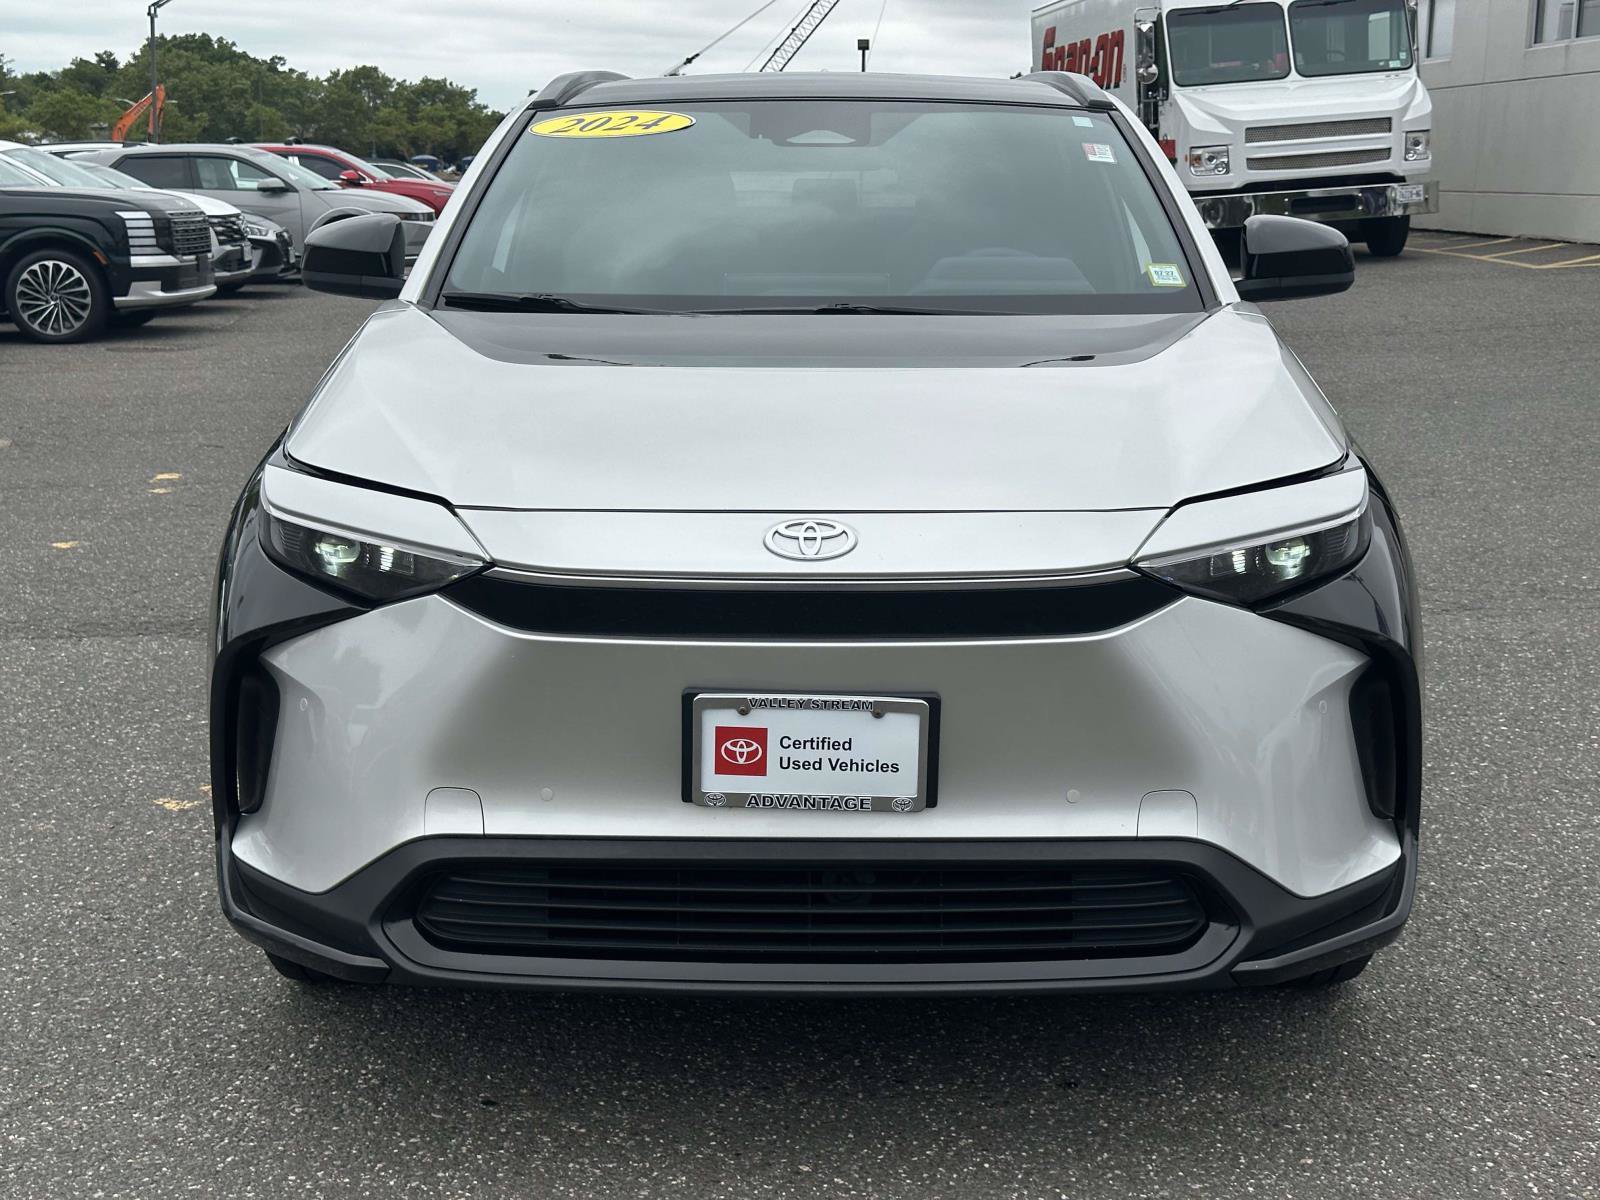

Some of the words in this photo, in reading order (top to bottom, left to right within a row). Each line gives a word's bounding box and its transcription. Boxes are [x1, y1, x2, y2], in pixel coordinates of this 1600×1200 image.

[548, 114, 672, 134] 2024
[747, 697, 805, 710] VALLEY
[810, 698, 875, 712] STREAM
[779, 735, 853, 751] Certified
[779, 756, 823, 771] Used
[827, 757, 900, 773] Vehicles
[745, 793, 873, 811] ADVANTAGE
